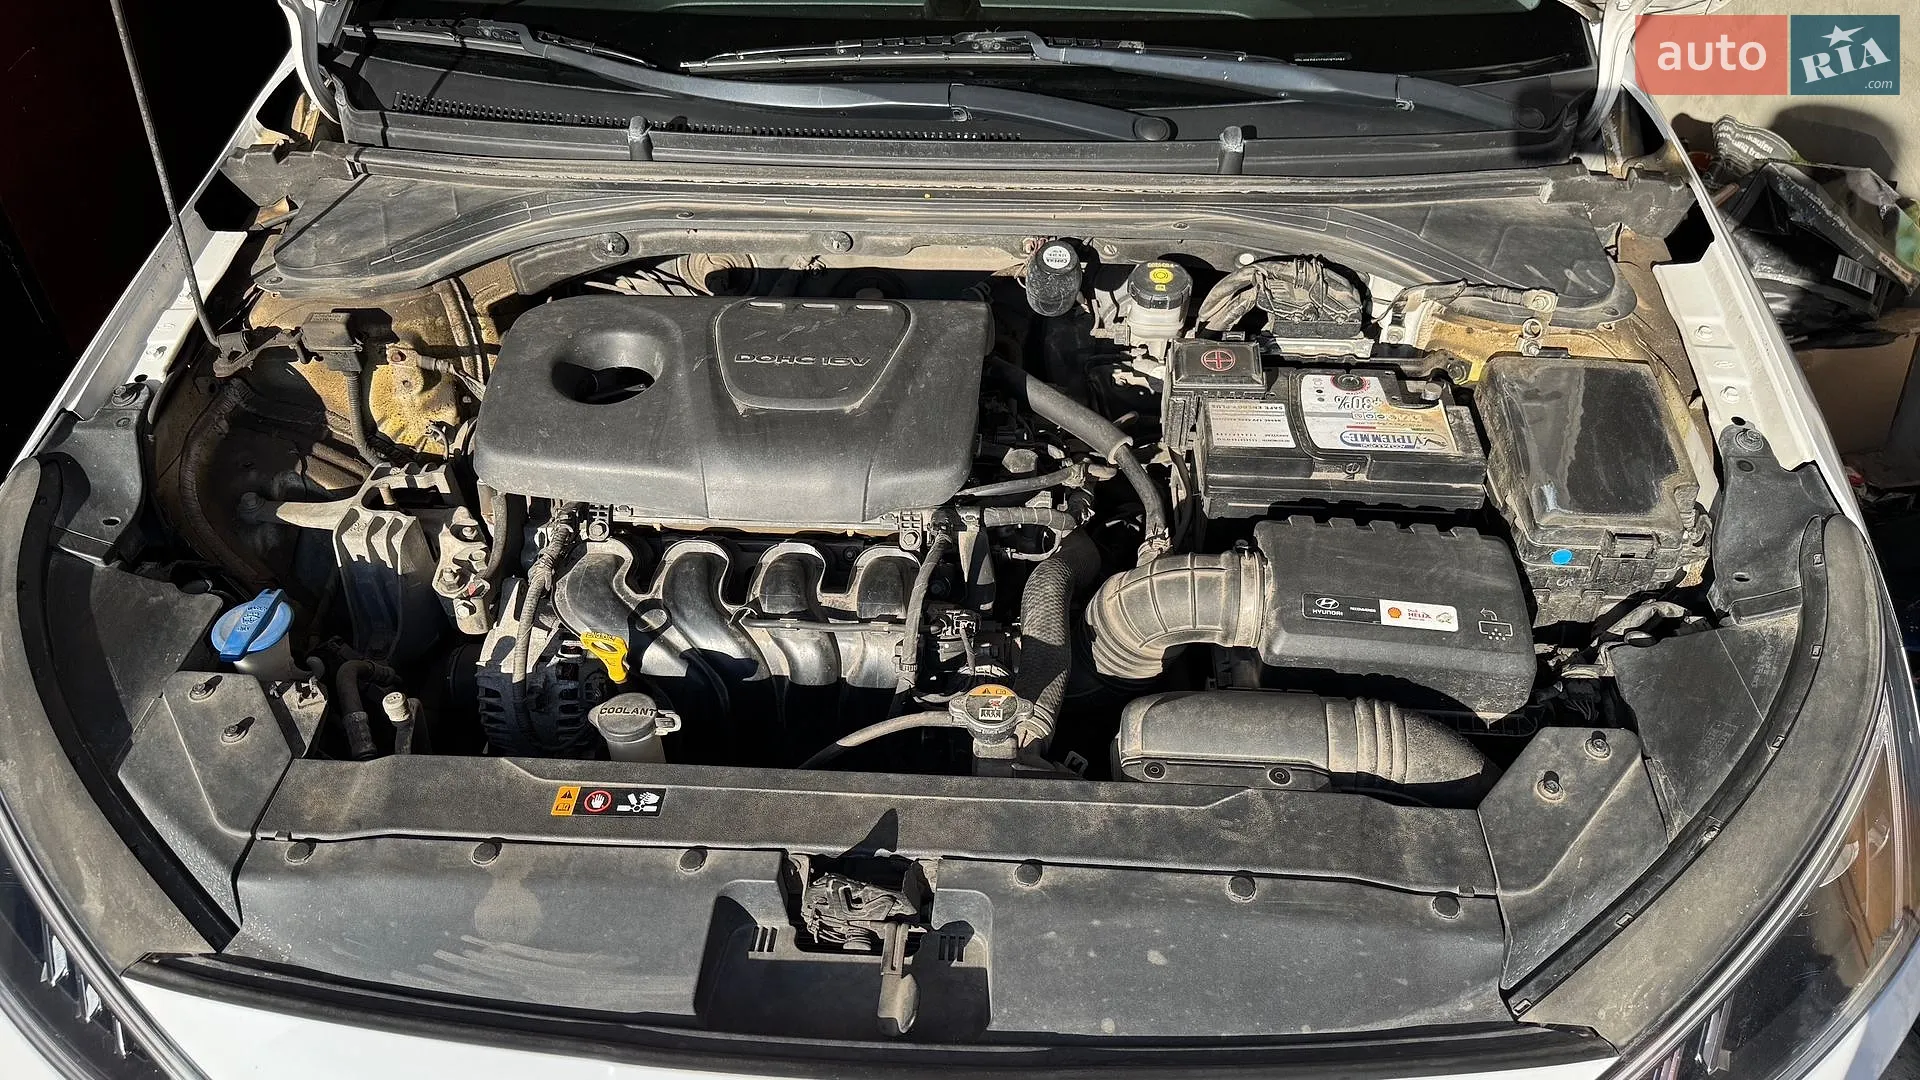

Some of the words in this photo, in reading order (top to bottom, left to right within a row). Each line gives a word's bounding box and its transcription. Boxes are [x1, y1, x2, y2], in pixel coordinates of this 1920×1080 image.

[735, 353, 815, 365] DOHC
[822, 356, 871, 367] 16V
[1312, 608, 1344, 617] HYUNDAI
[600, 707, 658, 717] COOLANT
